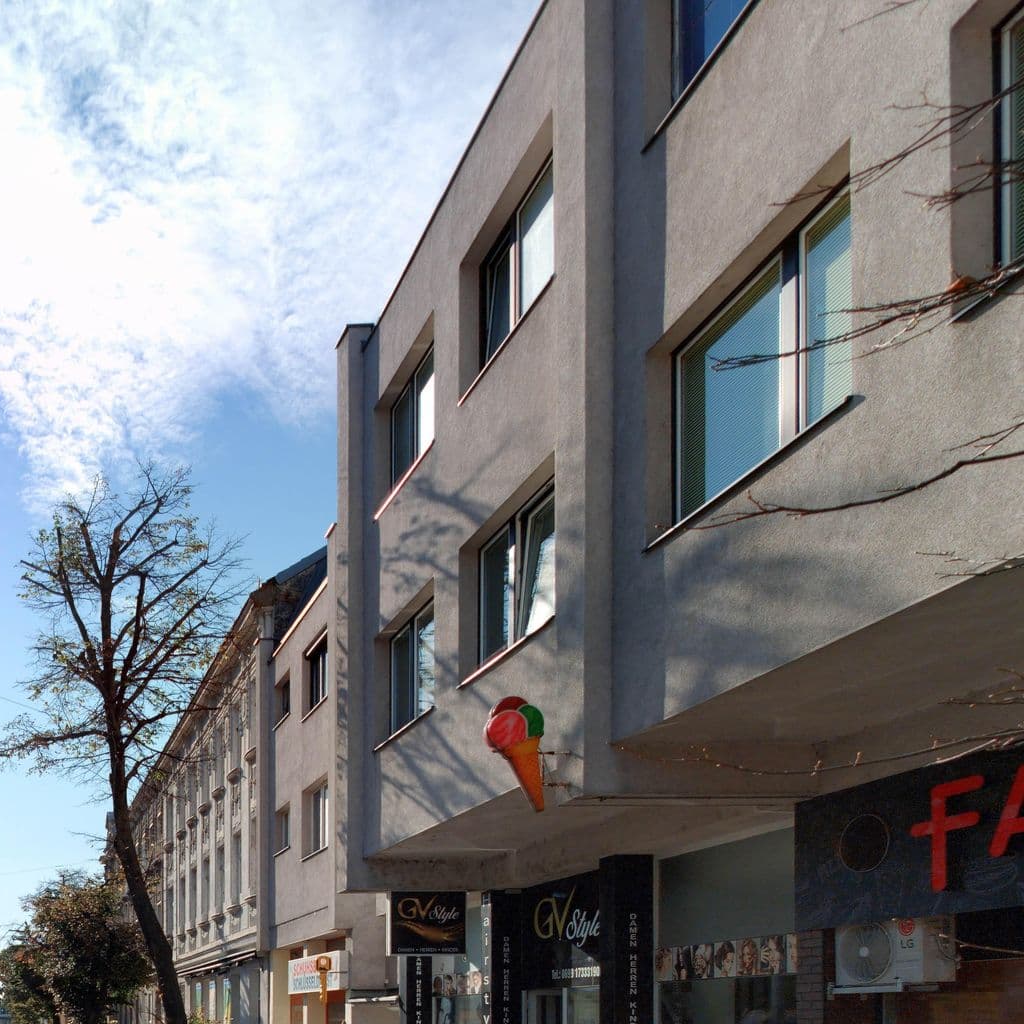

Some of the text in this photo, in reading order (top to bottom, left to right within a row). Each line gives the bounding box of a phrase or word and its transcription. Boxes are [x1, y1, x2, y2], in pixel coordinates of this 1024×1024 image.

[397, 895, 460, 924] GV Style
[533, 885, 601, 948] GV Style
[629, 913, 638, 947] DAMEN
[900, 938, 914, 949] LG
[629, 954, 638, 995] HERREN
